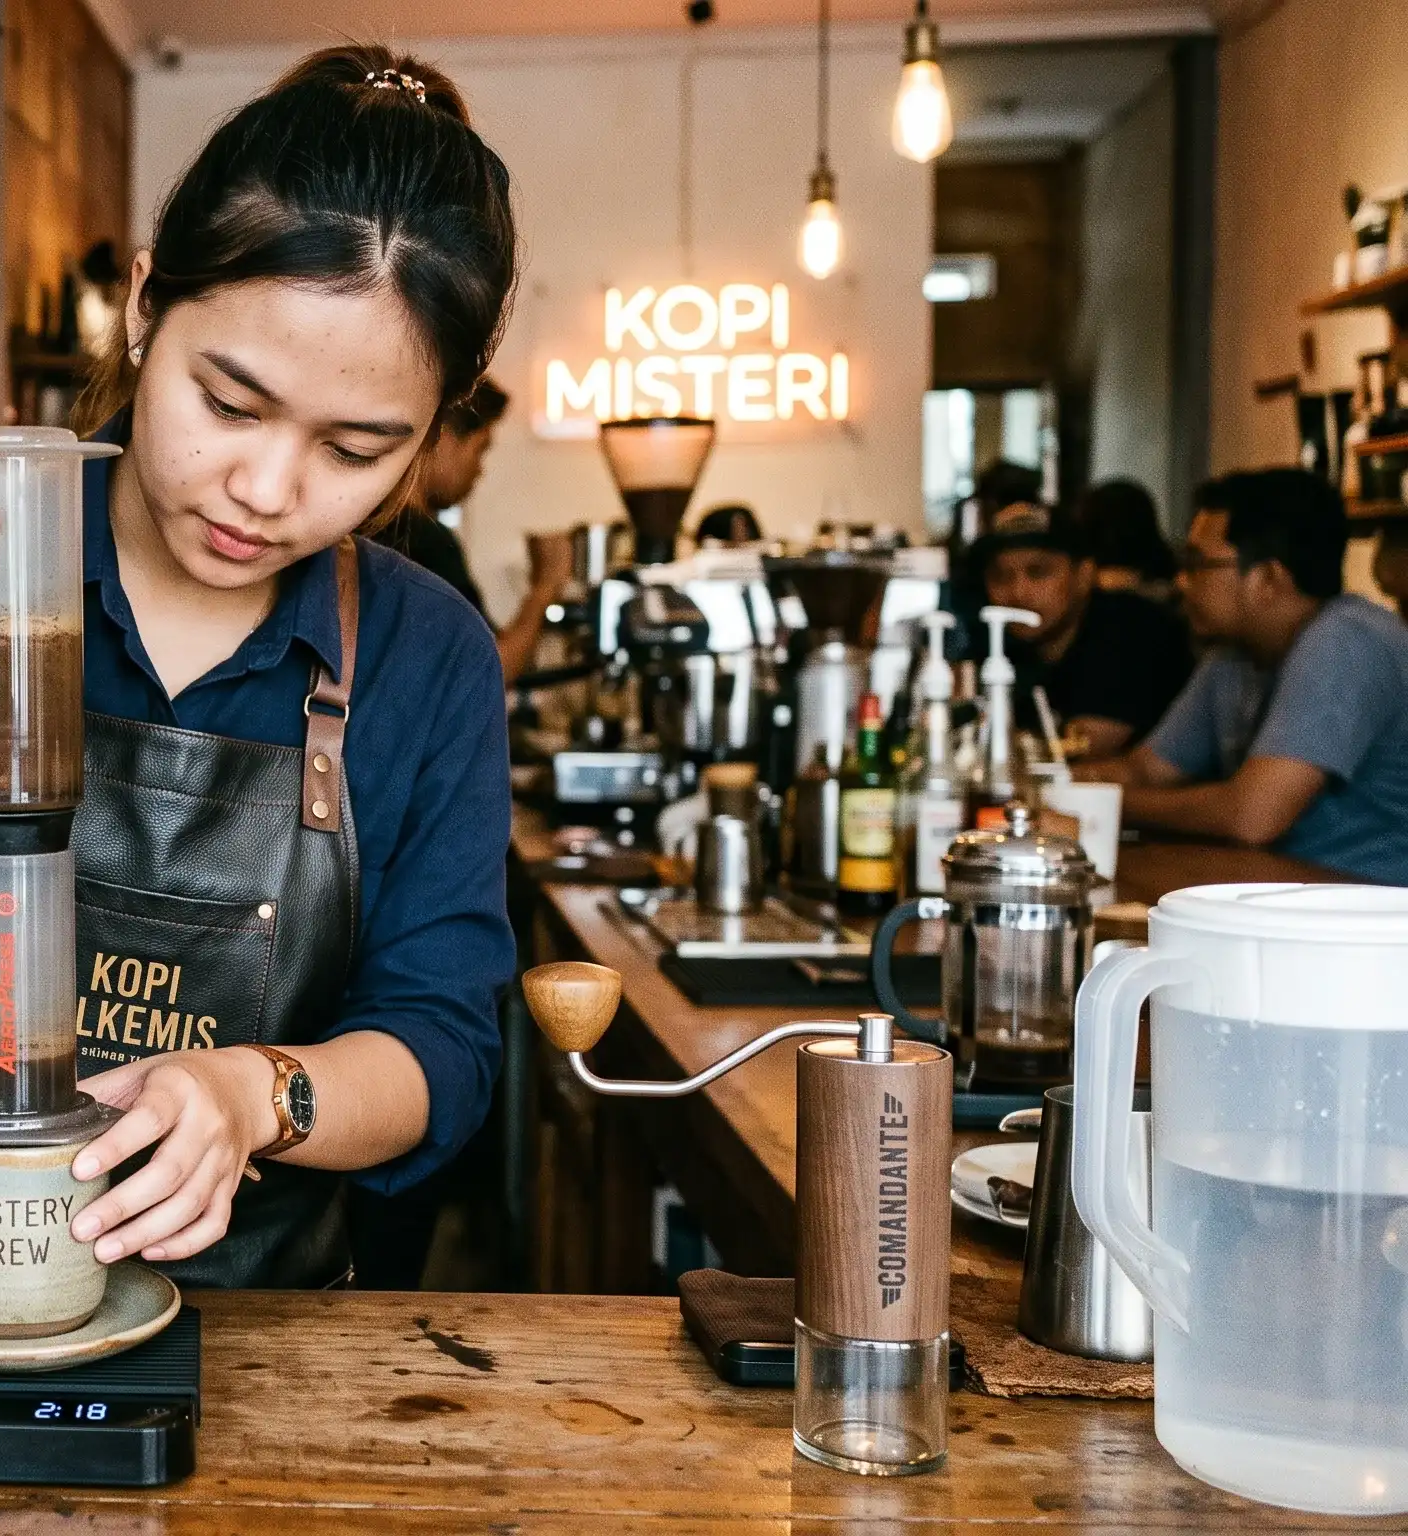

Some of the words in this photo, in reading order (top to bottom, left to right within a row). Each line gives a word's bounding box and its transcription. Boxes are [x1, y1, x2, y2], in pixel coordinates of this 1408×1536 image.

[604, 282, 789, 352] KOPI
[546, 352, 849, 424] MISTERI
[90, 952, 181, 1005] KOPI
[76, 996, 217, 1051] LKEMIS
[878, 1115, 908, 1286] COMANDANTE
[34, 1402, 107, 1420] 2:18
